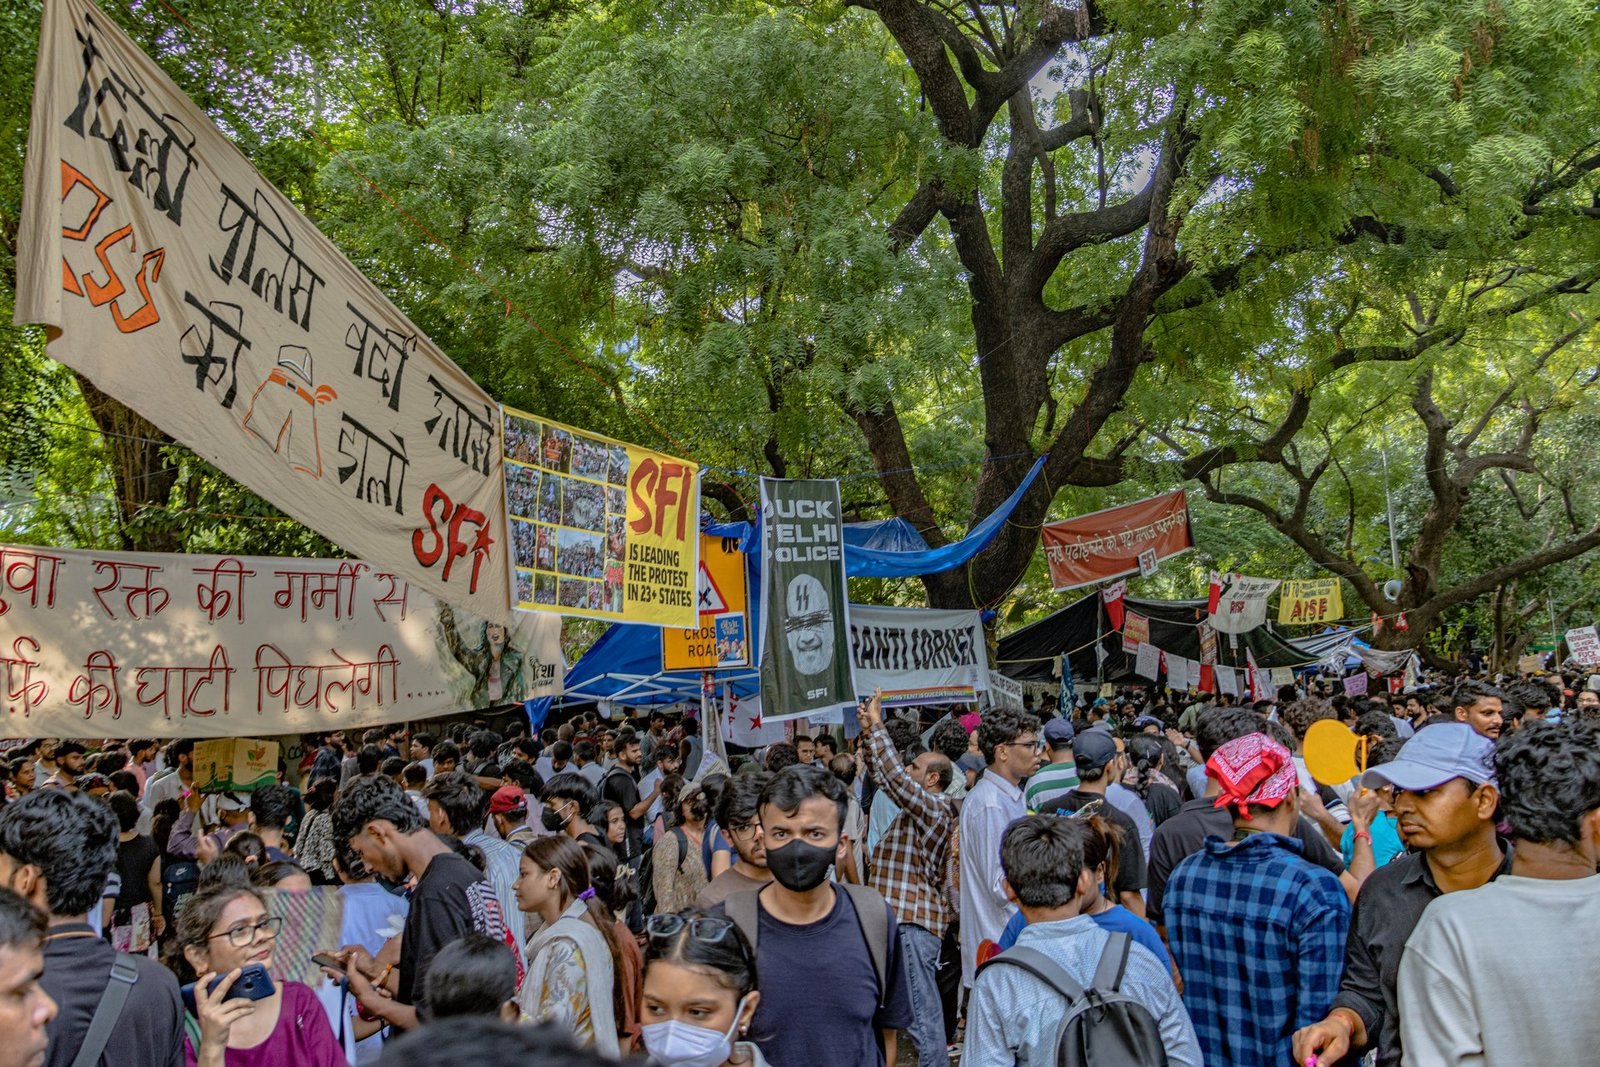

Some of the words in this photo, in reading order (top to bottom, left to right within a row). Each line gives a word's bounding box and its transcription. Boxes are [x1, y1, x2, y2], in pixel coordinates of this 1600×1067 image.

[63, 12, 199, 227] दिल्ली
[208, 183, 325, 332] पुलिस
[338, 411, 410, 515] डालो
[629, 458, 690, 541] SFI
[630, 543, 640, 561] IS
[641, 545, 680, 567] LEADING
[0, 550, 66, 616] वा
[91, 559, 170, 620] रक्त
[191, 558, 257, 624] की
[274, 562, 369, 623] गर्मी
[372, 572, 410, 621] स
[628, 563, 648, 582] THE
[648, 566, 689, 588] PROTEST
[627, 582, 640, 601] IN
[640, 584, 658, 602] 23+
[659, 586, 692, 608] STATES
[1290, 597, 1328, 622] AISF
[684, 626, 716, 640] CROS
[911, 625, 978, 670] CORNER
[68, 650, 121, 719] की
[134, 644, 236, 719] घाटी
[807, 686, 828, 700] SFI
